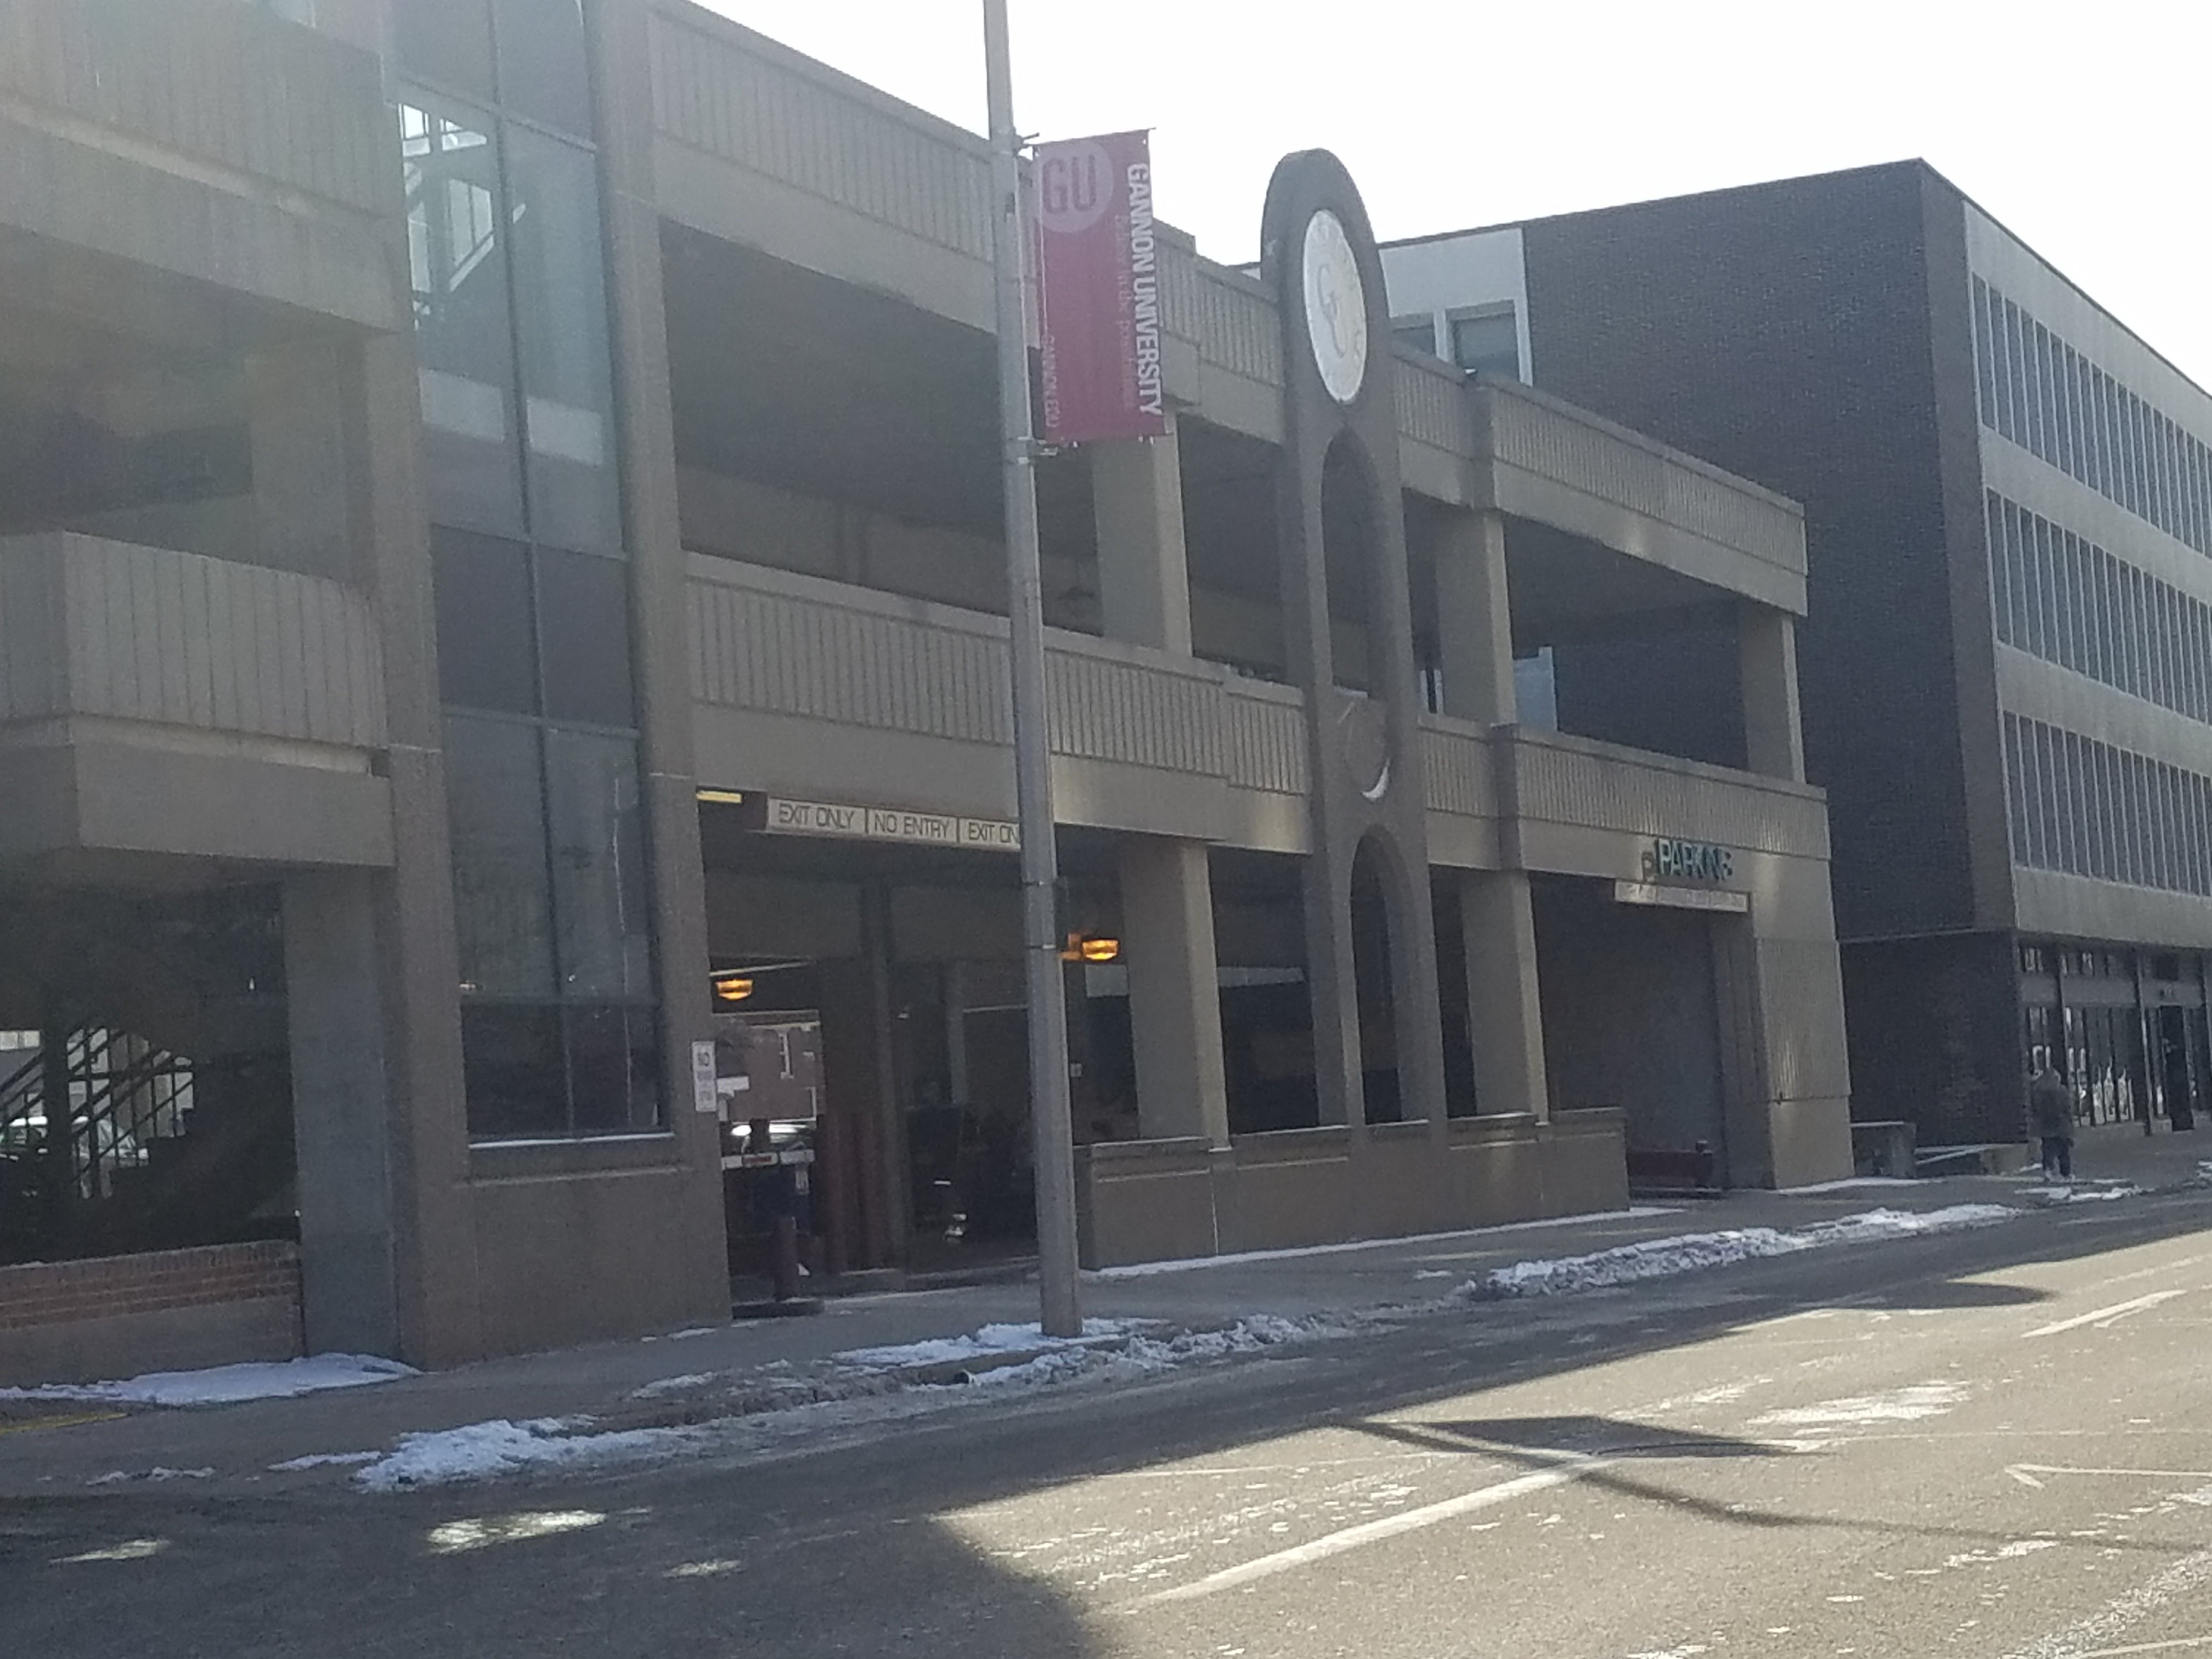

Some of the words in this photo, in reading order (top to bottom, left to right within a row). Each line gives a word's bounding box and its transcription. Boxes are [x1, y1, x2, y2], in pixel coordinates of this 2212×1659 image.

[1042, 154, 1097, 215] GU
[1128, 163, 1155, 273] GANNON
[1133, 275, 1163, 416] UNIVERSITY
[779, 803, 810, 826] EXIT
[816, 806, 854, 830] ONLY
[874, 812, 898, 833] NO
[904, 816, 949, 838] ENTRY
[969, 822, 995, 841] EXIT
